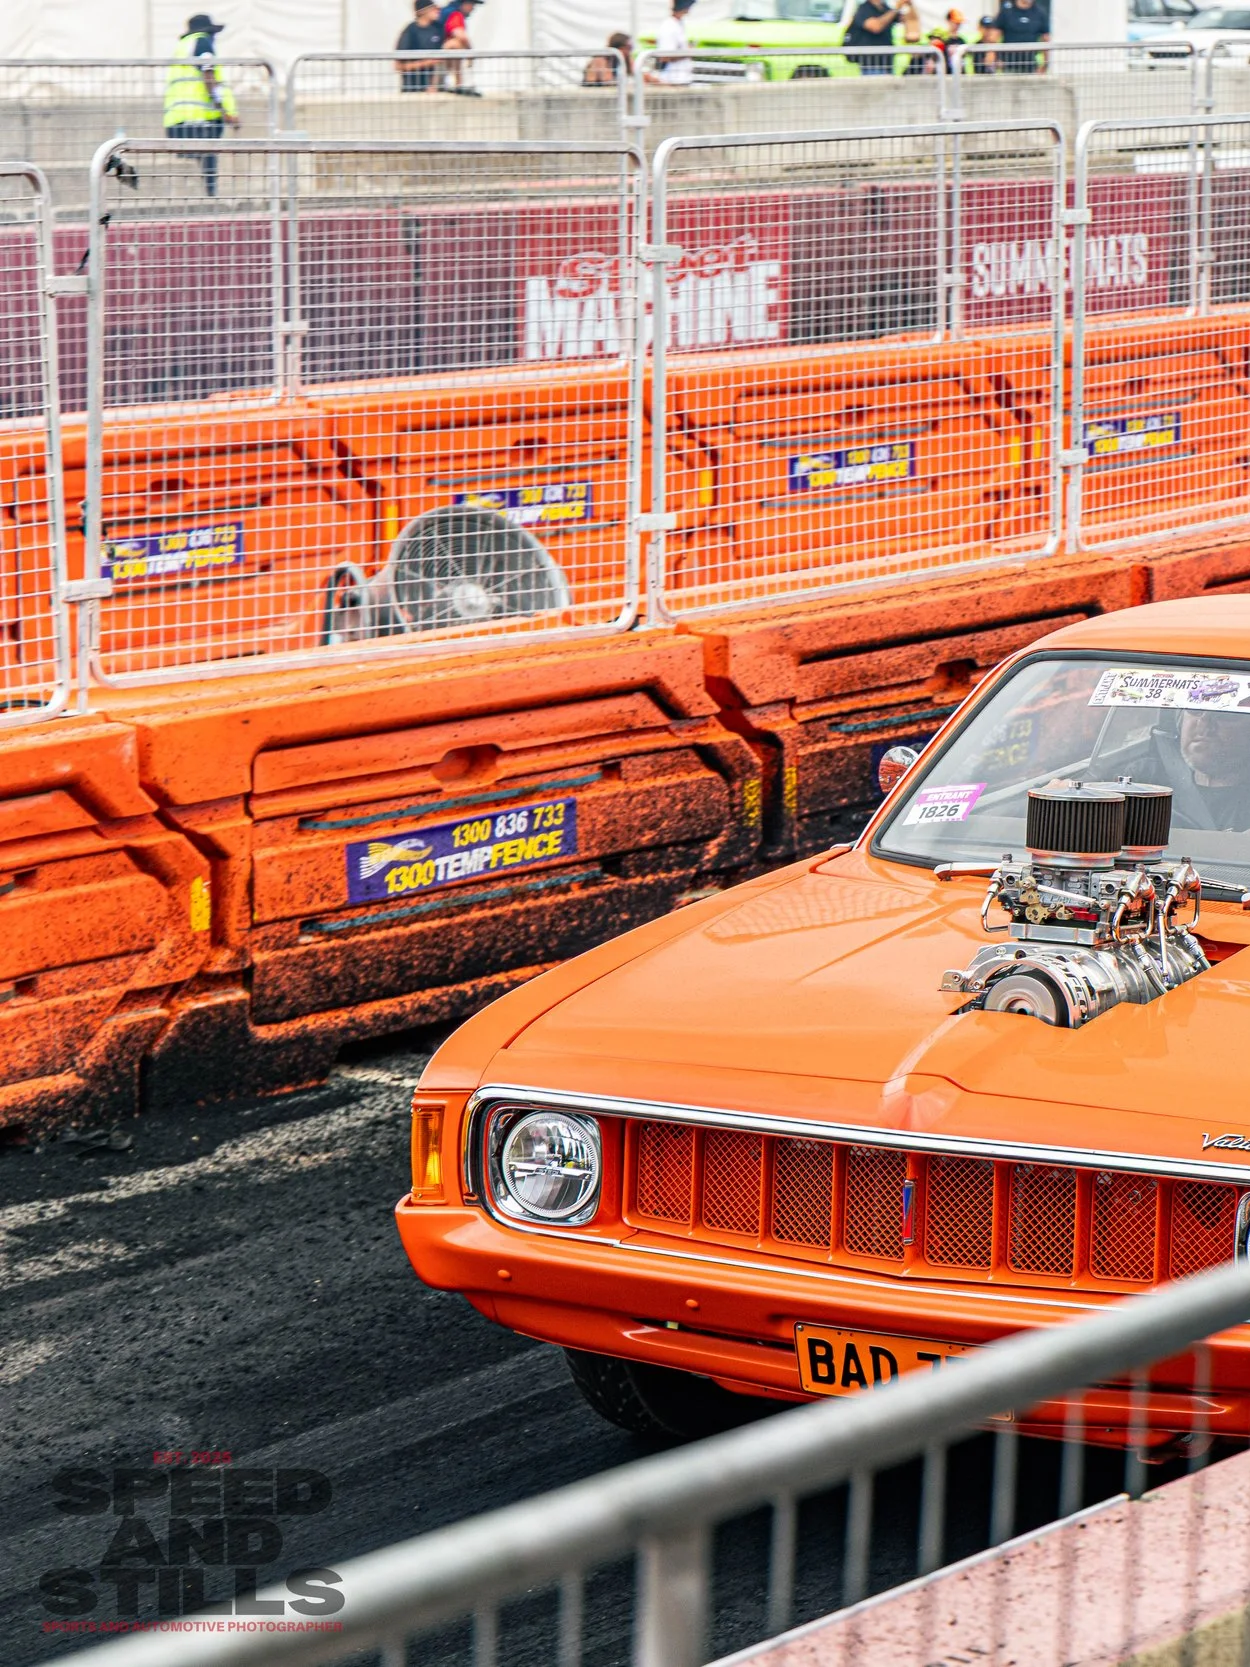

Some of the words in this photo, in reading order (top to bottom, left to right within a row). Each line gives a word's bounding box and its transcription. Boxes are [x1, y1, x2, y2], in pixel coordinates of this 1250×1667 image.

[556, 232, 758, 298] Steet
[972, 233, 1149, 297] SUMMENATS
[1120, 676, 1201, 690] SUMMERNATS
[1145, 689, 1163, 699] 38
[919, 804, 960, 819] 1826
[925, 791, 974, 801] ENTRANT
[452, 819, 492, 849] 1300
[494, 810, 529, 838] 836
[532, 803, 566, 830] 733
[384, 830, 564, 894] 1300TEMPFENCE
[807, 1337, 899, 1391] BAD
